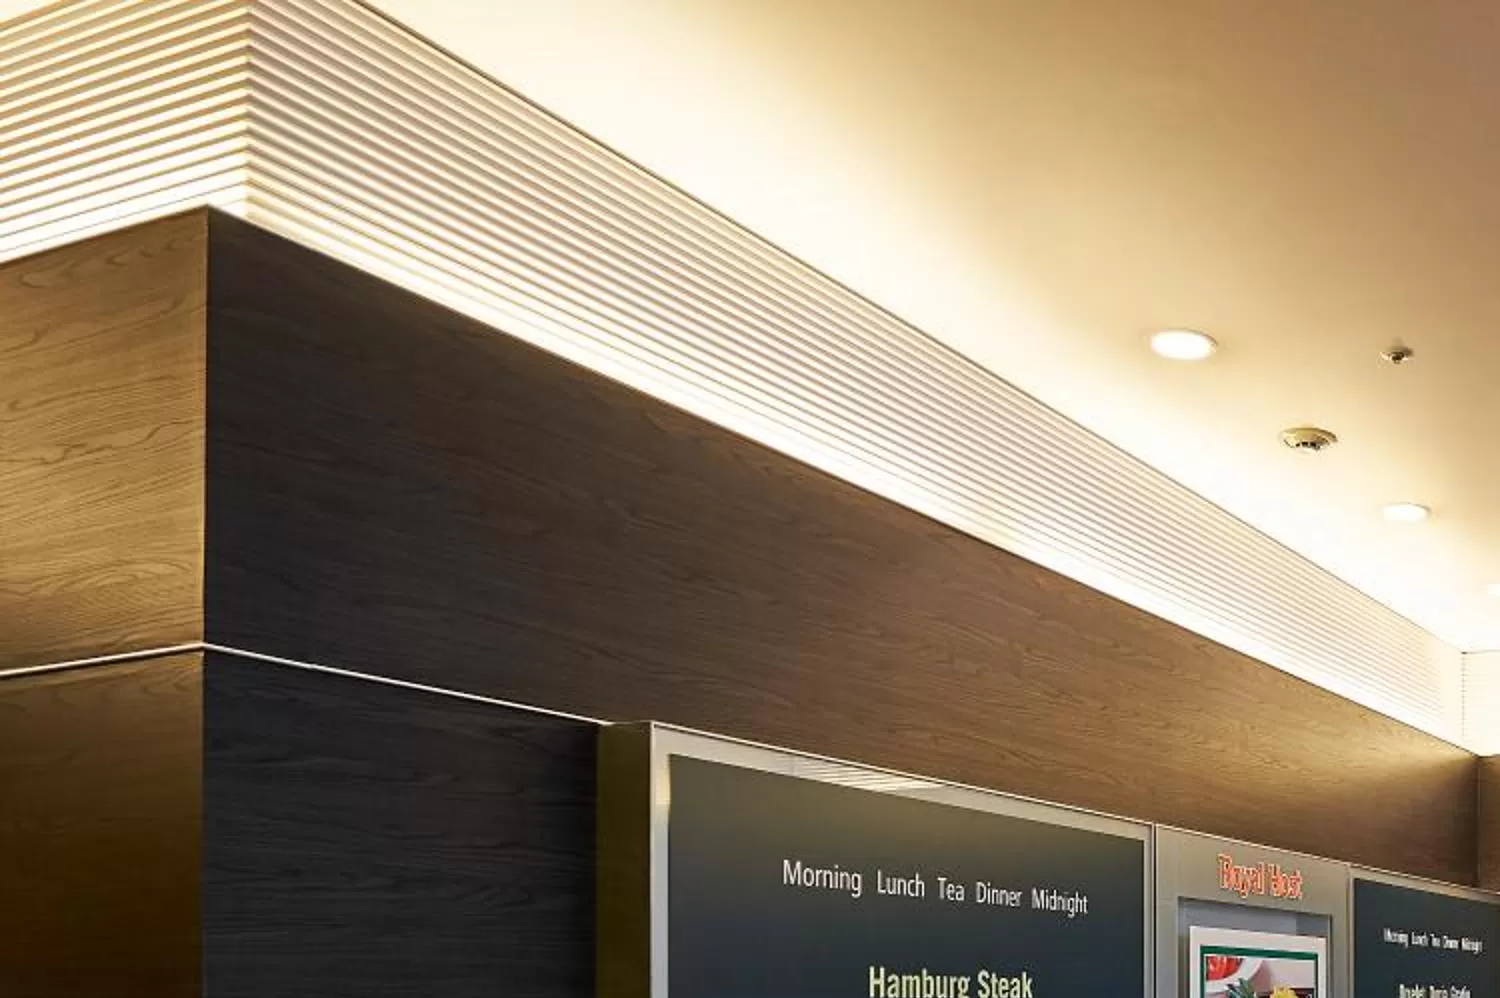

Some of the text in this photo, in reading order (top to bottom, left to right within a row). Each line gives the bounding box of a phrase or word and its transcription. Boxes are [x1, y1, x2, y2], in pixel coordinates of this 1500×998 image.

[783, 859, 1089, 919] Morning Lunch Tea Dinner Midnight
[1217, 853, 1303, 899] Royal Host
